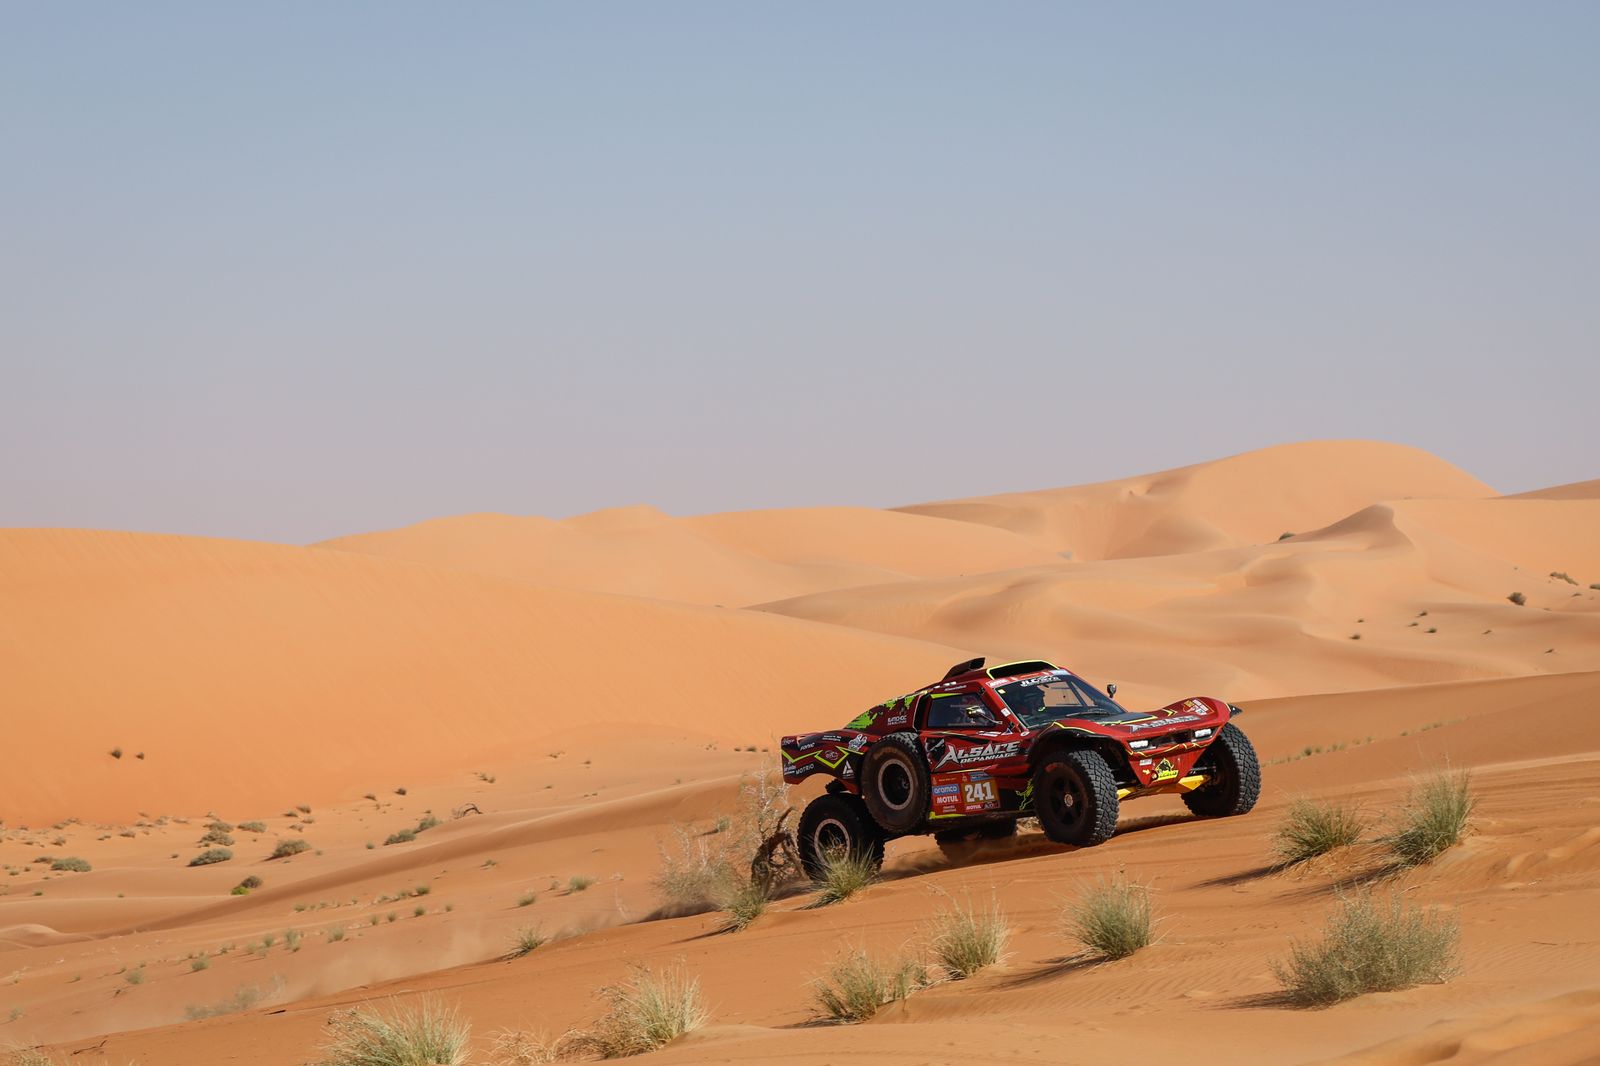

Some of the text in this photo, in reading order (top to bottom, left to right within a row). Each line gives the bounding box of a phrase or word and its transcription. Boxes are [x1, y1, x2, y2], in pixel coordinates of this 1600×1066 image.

[935, 741, 1020, 770] ALSACE
[960, 752, 1017, 764] DEPANNAGE
[934, 785, 958, 794] aramco
[964, 781, 995, 803] 241
[936, 795, 959, 804] MOTUL
